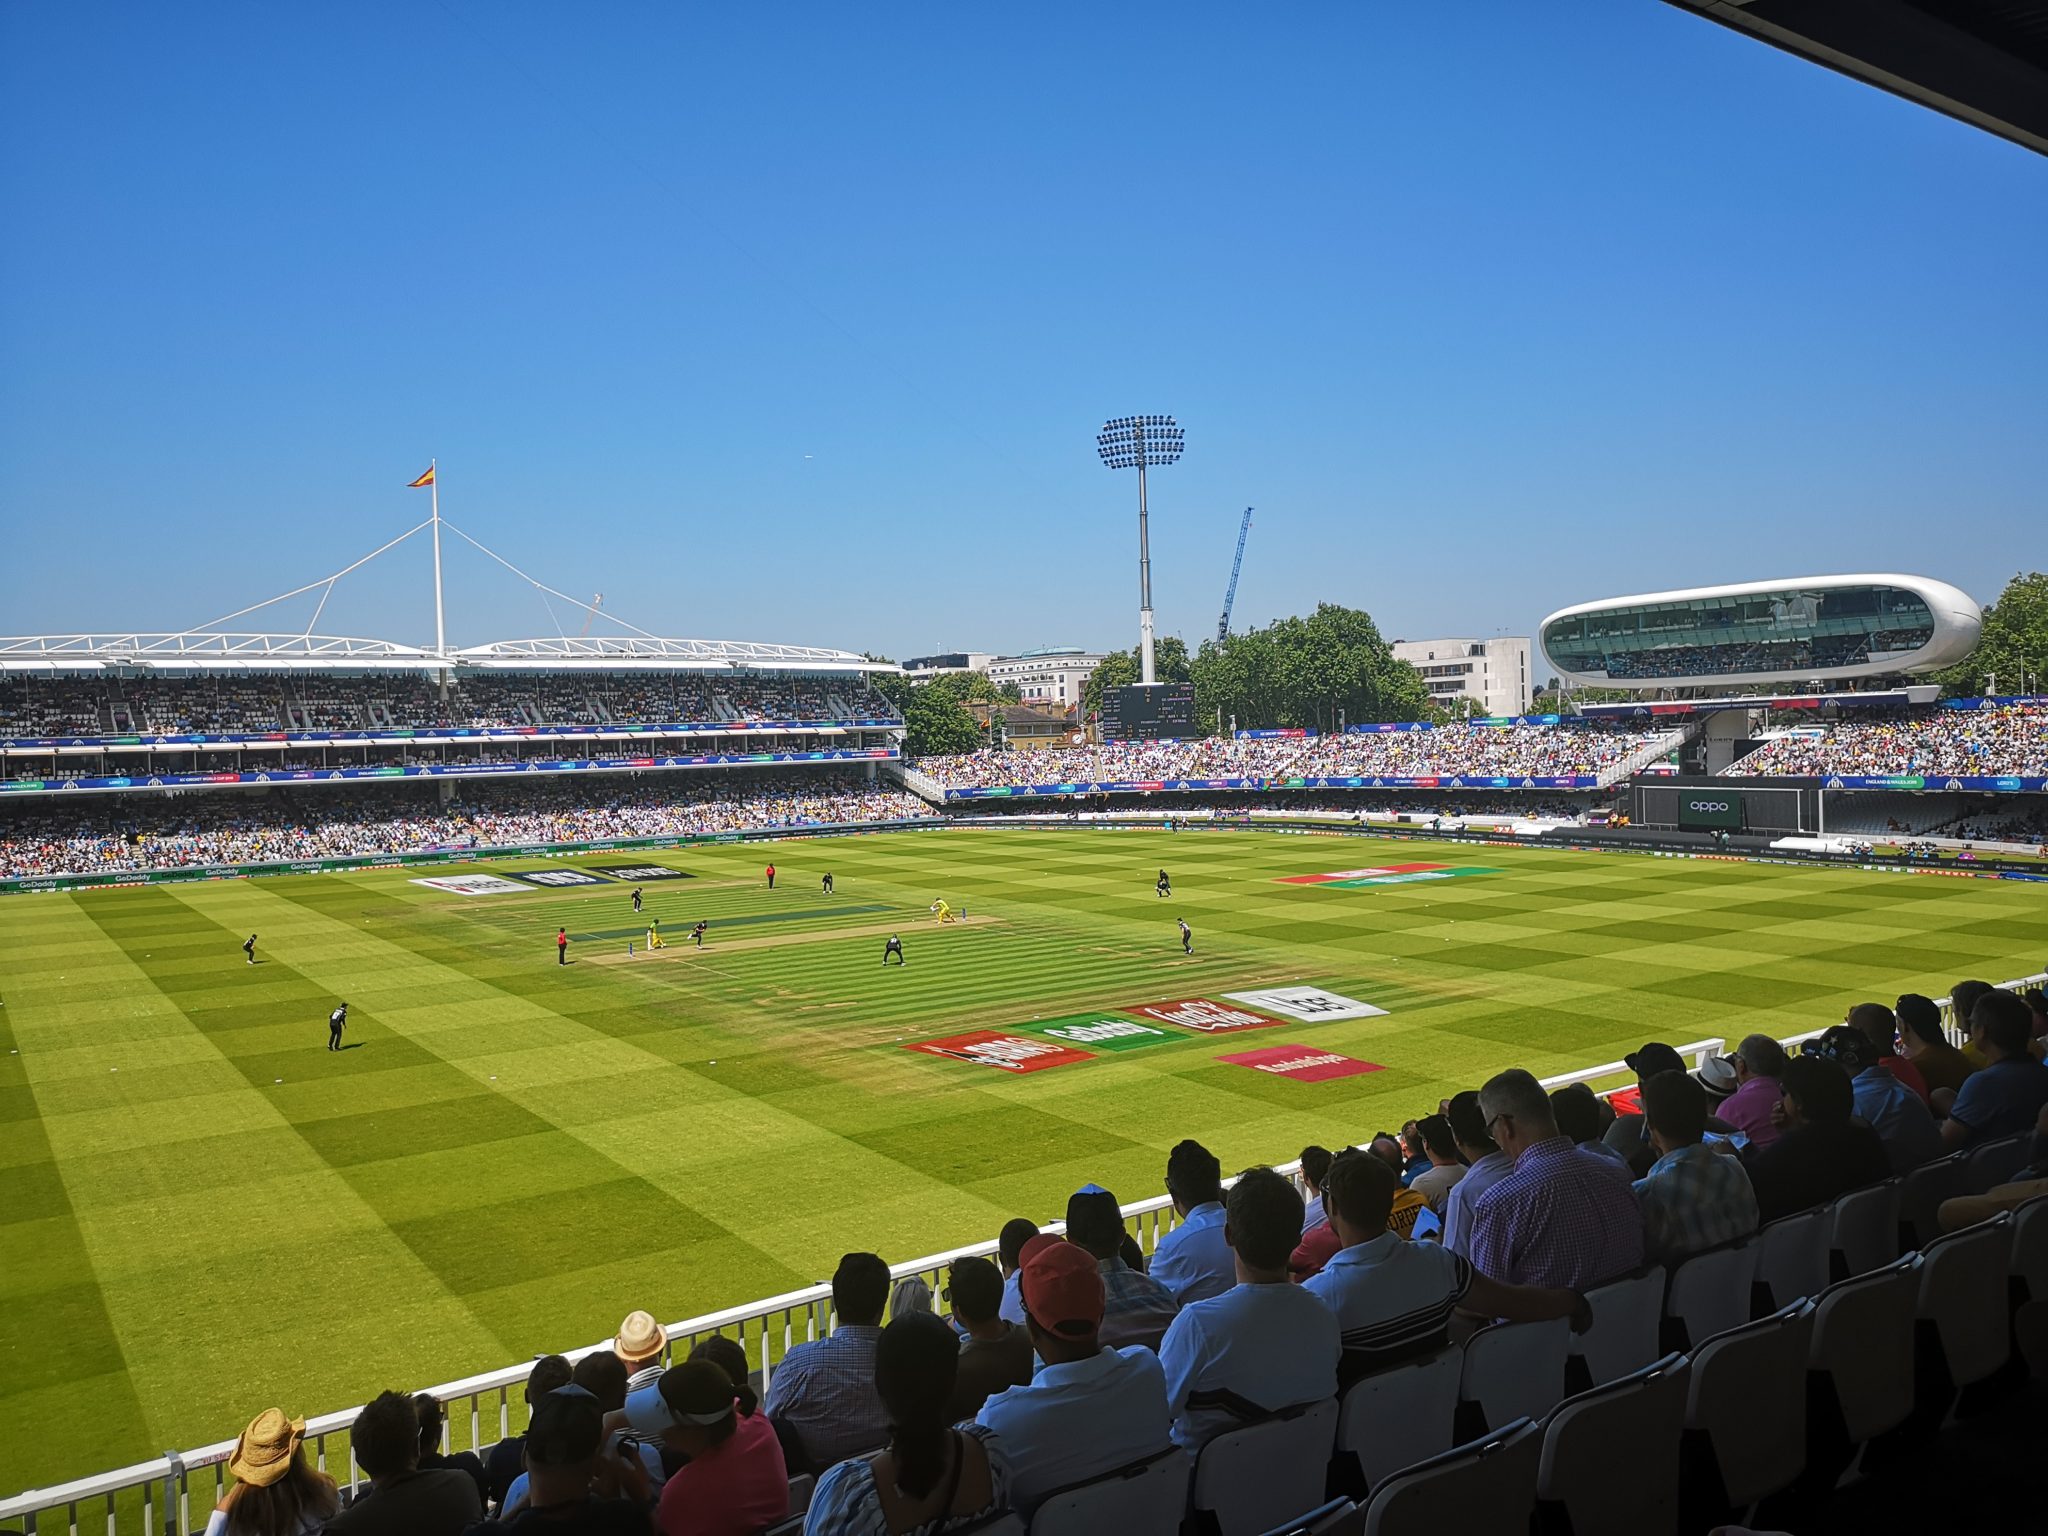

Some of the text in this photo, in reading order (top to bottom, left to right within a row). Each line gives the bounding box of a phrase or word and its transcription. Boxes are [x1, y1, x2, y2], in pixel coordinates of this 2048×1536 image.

[291, 862, 322, 870] GoDaddy
[115, 874, 150, 882] GoDaddy
[1258, 996, 1352, 1013] Uber
[1043, 1019, 1164, 1042] GoDaddy
